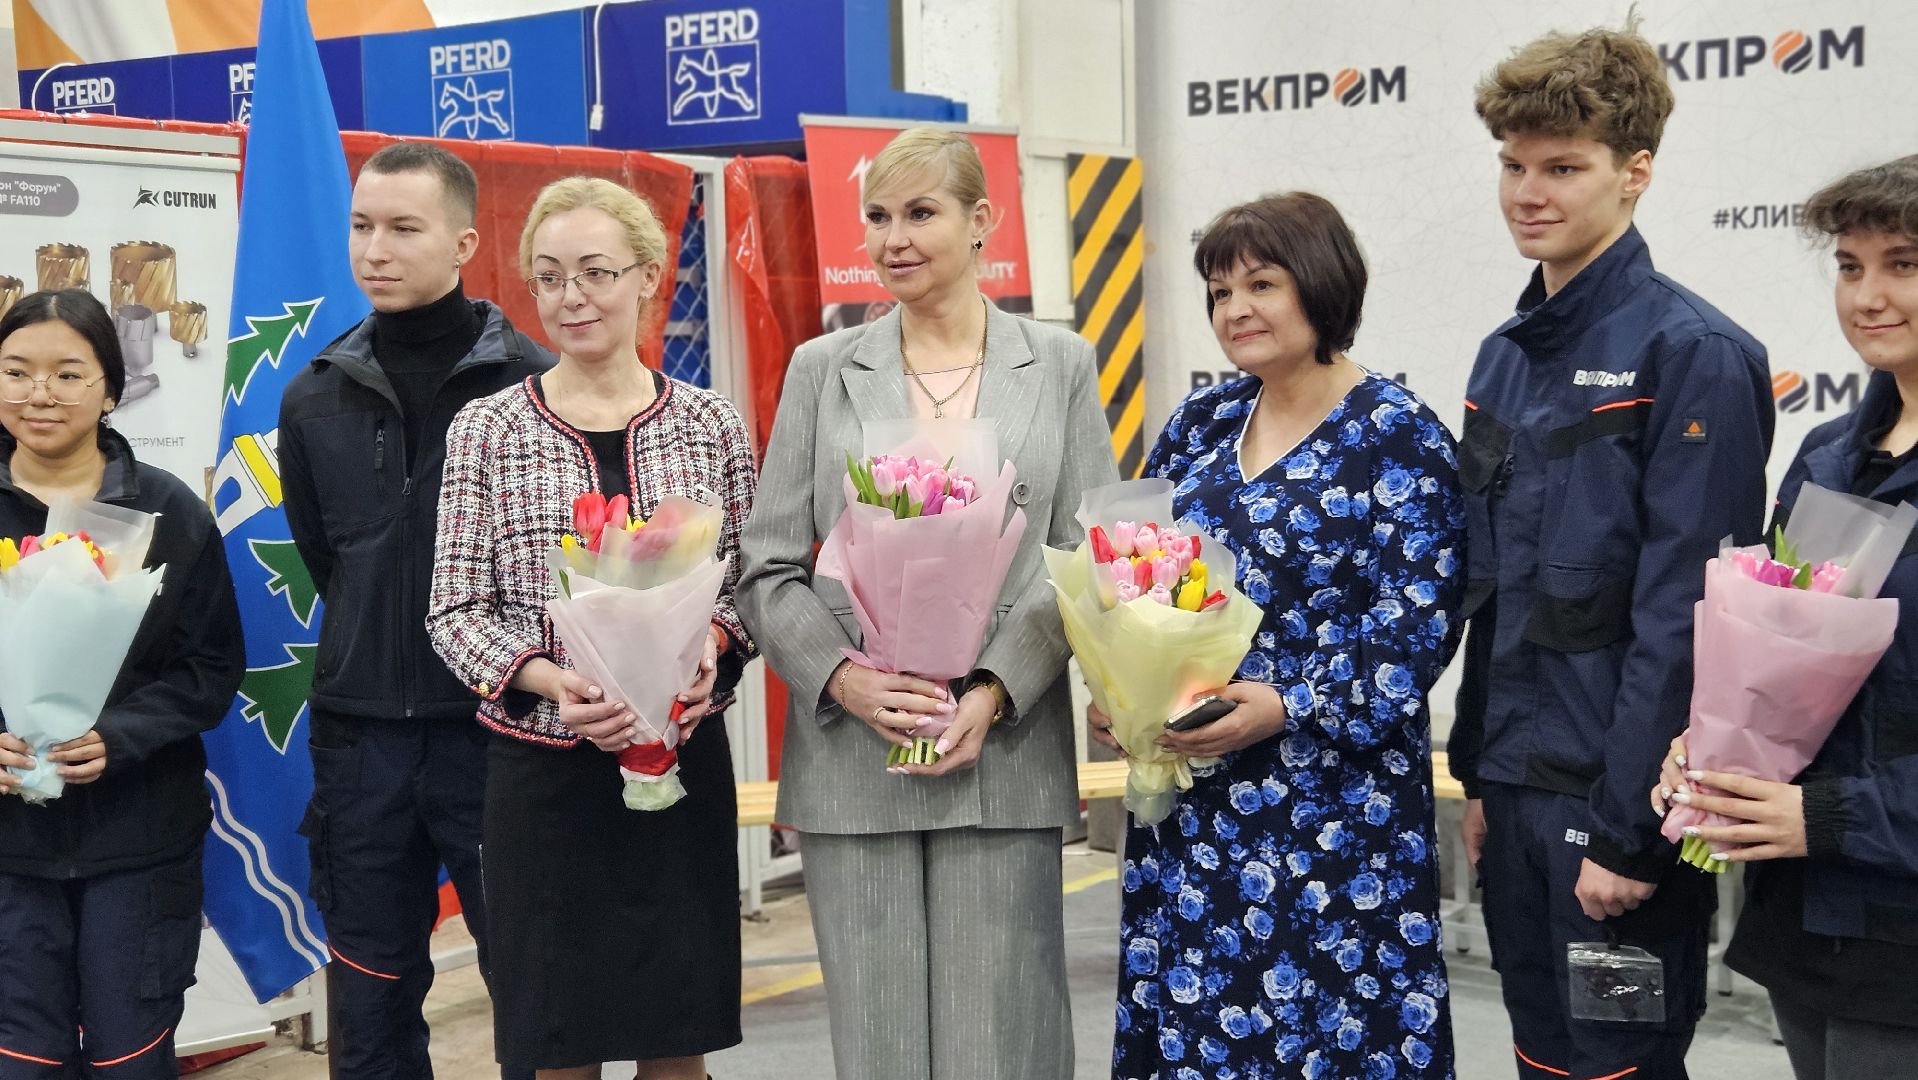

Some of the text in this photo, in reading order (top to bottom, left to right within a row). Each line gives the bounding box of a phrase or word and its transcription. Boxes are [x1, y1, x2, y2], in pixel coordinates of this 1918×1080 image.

[665, 8, 760, 47] PFERD
[430, 39, 511, 75] PFERD
[1657, 24, 1865, 82] КПРОМ
[52, 77, 115, 107] PFERD
[1187, 65, 1407, 117] ВЕКПРОМ
[10, 194, 41, 207] FA110
[163, 190, 217, 209] CUTRUN
[1711, 204, 1806, 230] #КЛИЕ
[128, 436, 185, 448] СТРУМЕНТ
